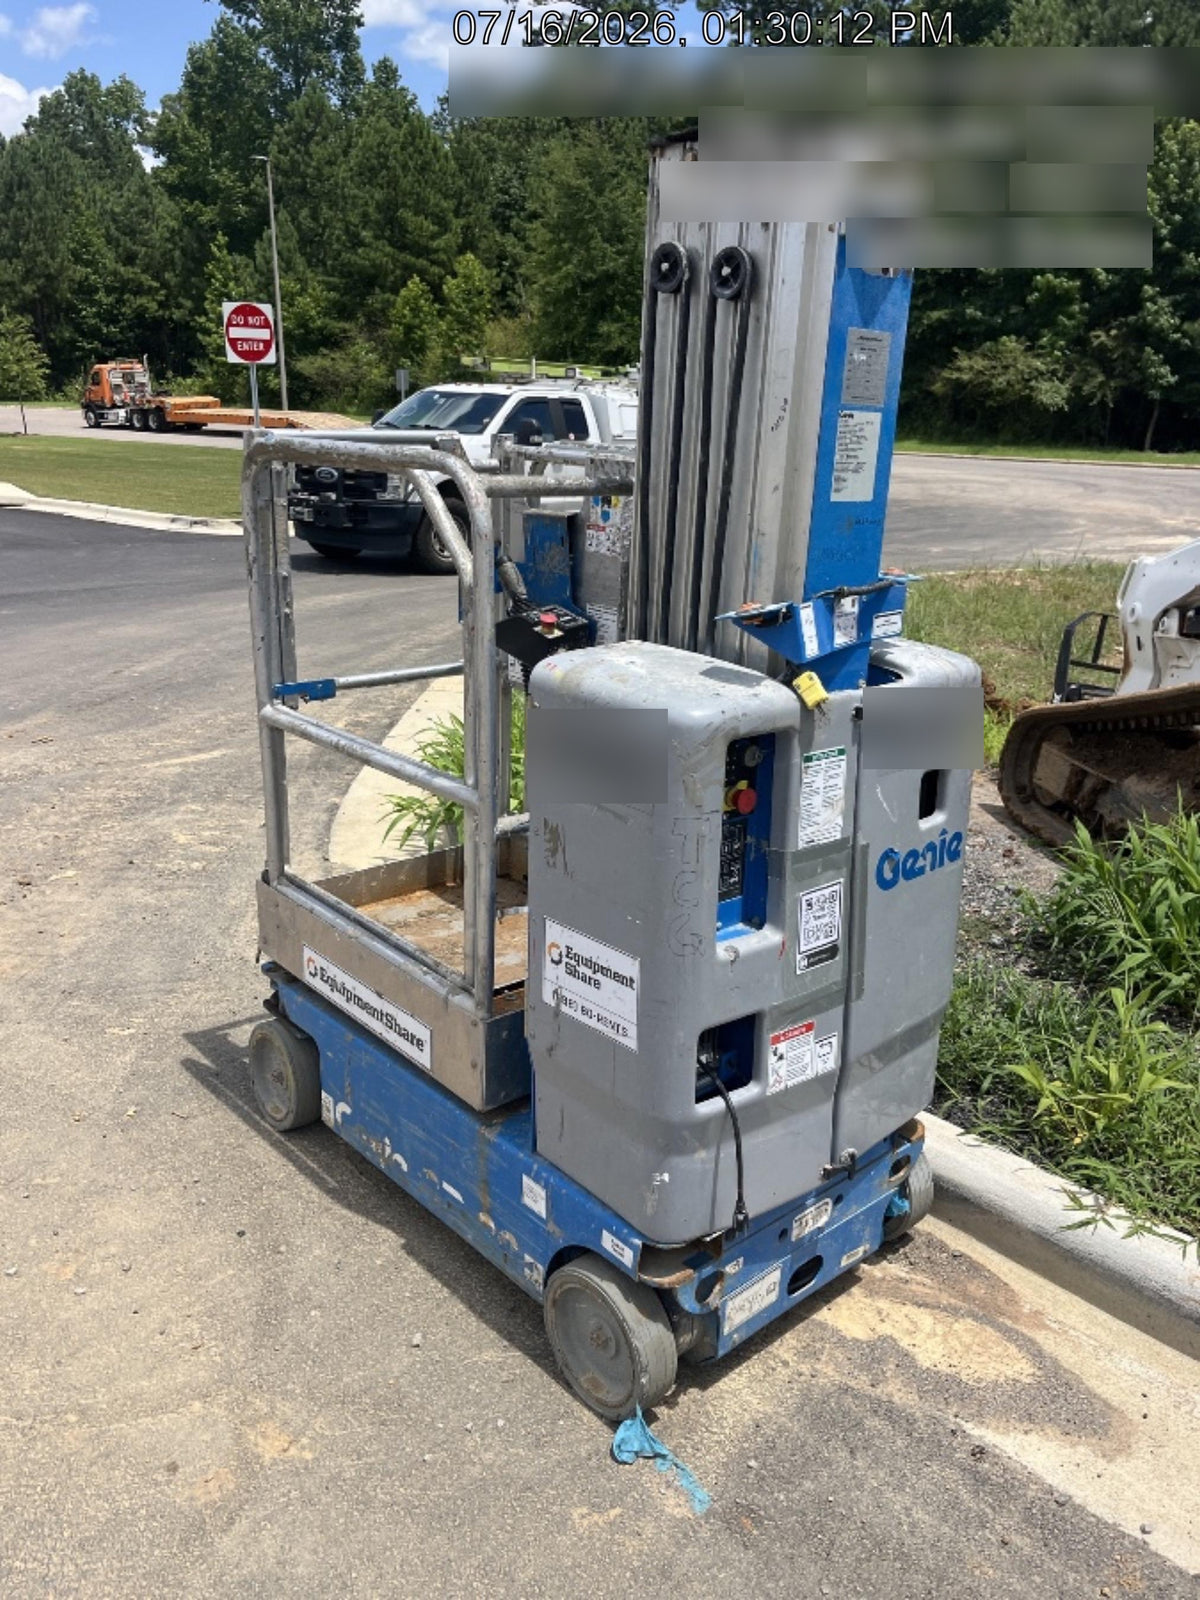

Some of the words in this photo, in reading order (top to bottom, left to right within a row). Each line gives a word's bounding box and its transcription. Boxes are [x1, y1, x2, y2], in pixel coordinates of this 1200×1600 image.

[230, 314, 245, 325] DO
[247, 315, 266, 326] NOT
[236, 340, 265, 351] ENTER
[875, 827, 964, 891] Genie
[564, 944, 636, 991] Equipment
[564, 961, 602, 990] Share
[319, 965, 425, 1053] EquipmentShare
